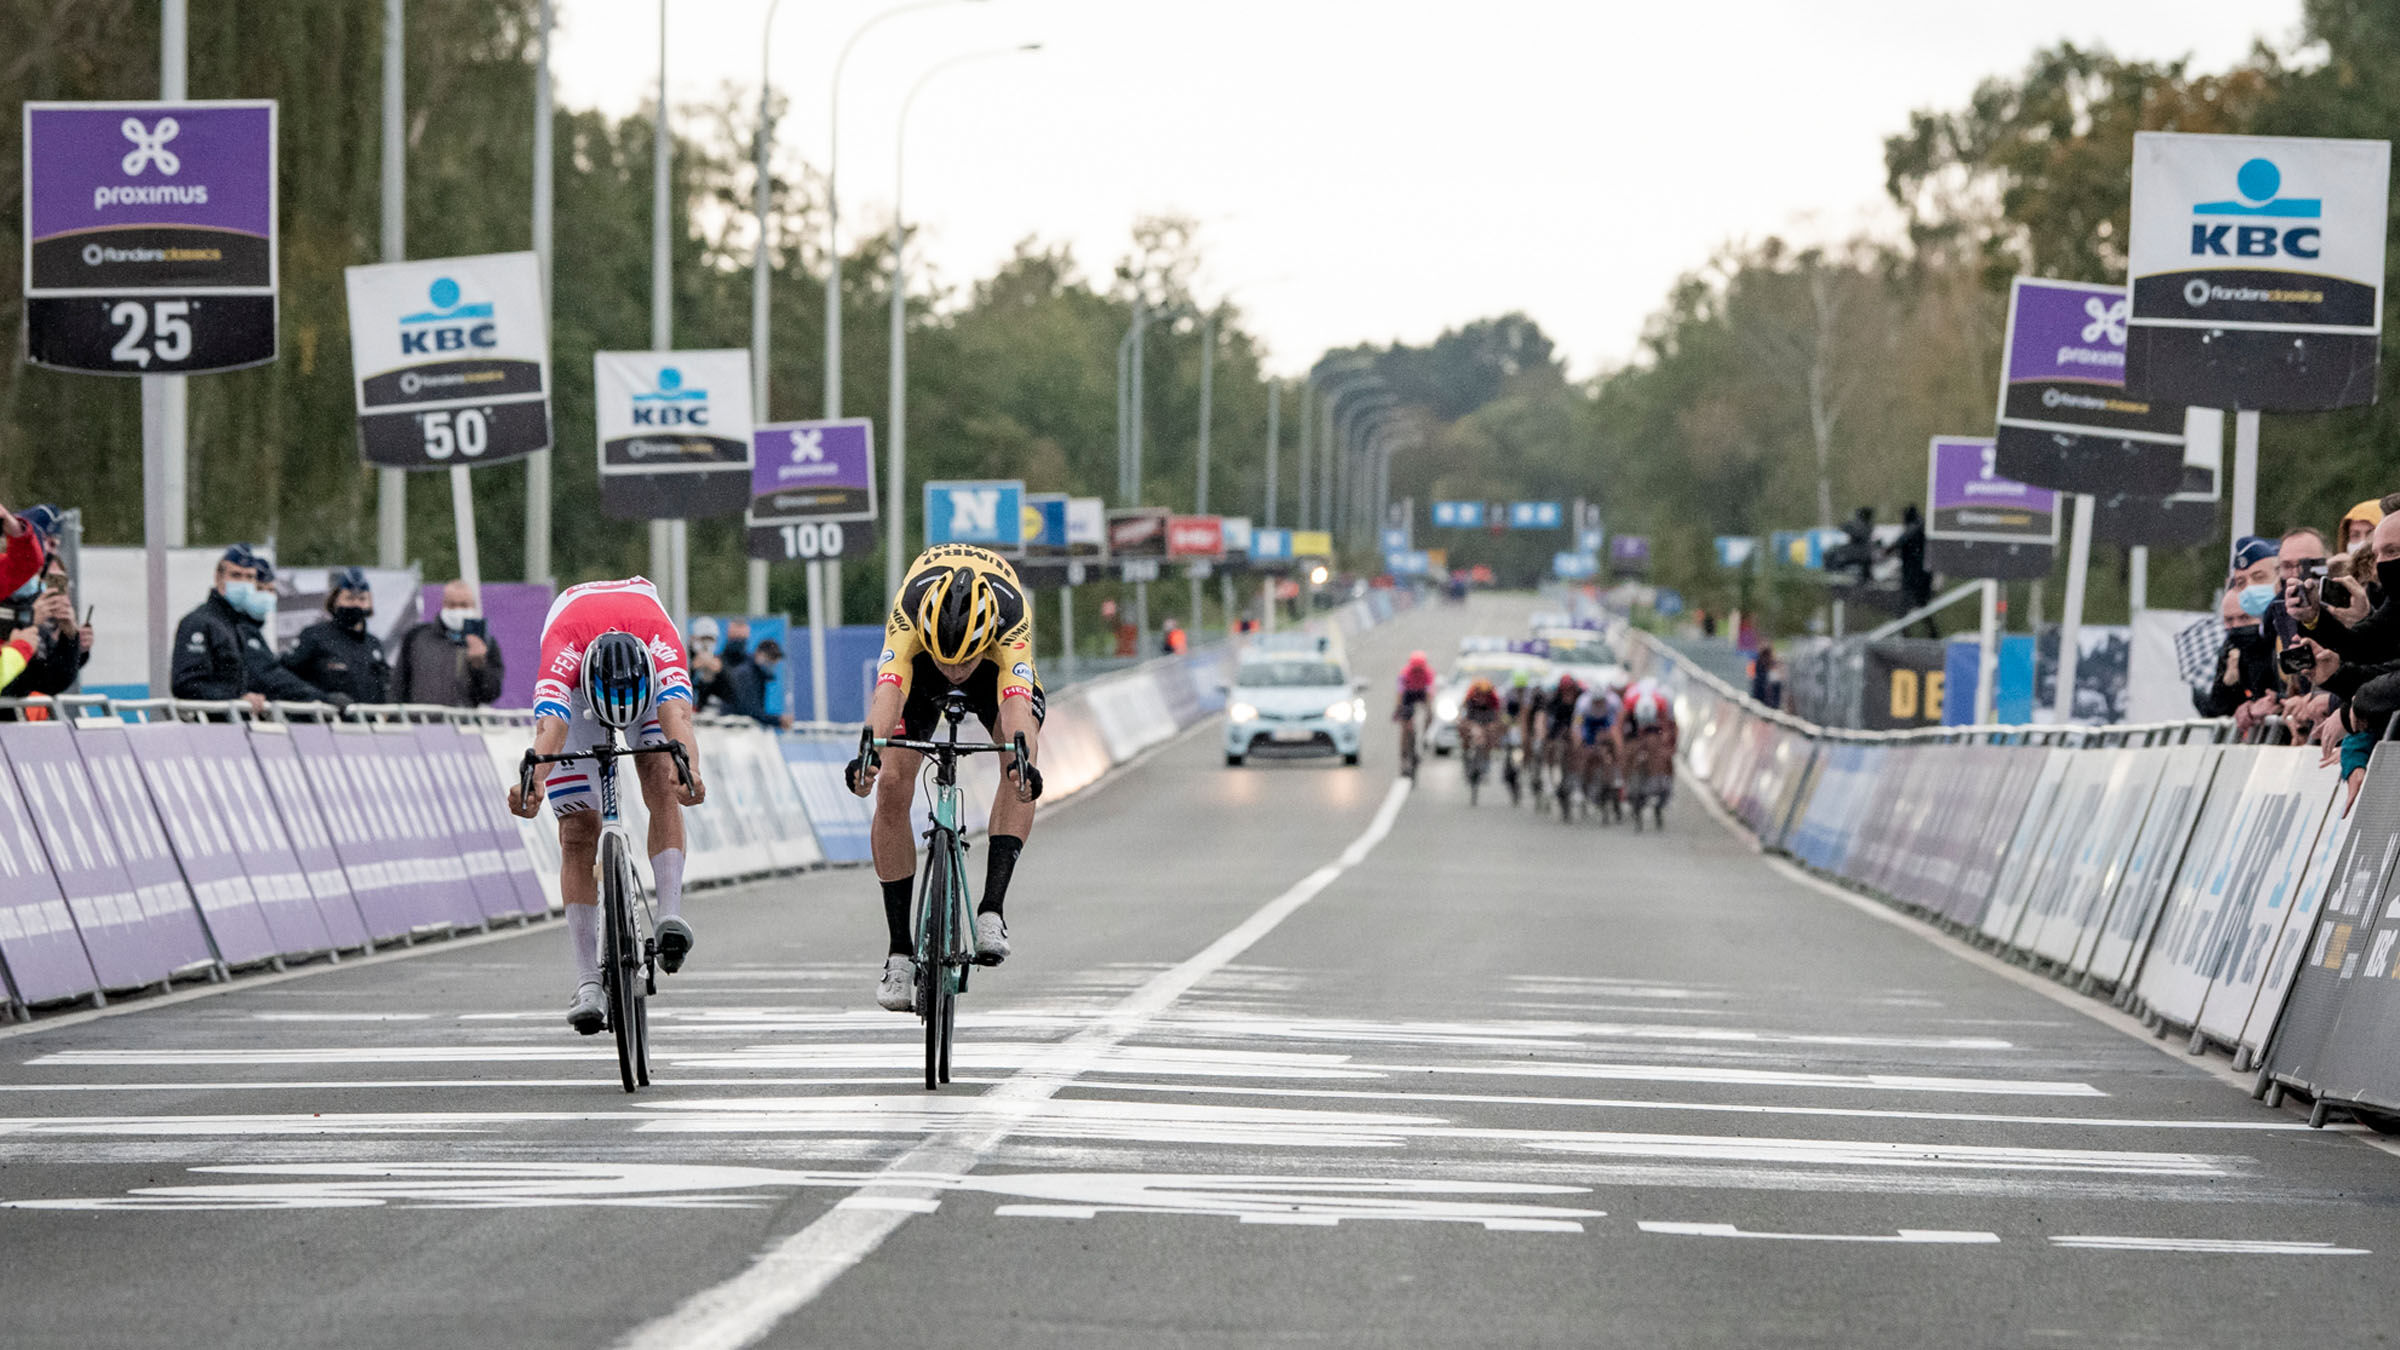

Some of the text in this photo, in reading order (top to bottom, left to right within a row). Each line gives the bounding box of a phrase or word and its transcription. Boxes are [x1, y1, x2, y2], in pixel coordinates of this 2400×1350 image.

[94, 185, 208, 210] proximus
[2191, 224, 2320, 259] KBC
[111, 302, 192, 367] 25
[401, 324, 497, 354] KBC
[2057, 346, 2126, 367] proxim
[423, 408, 488, 459] 50
[633, 406, 708, 426] KBC
[952, 491, 999, 530] N
[780, 523, 843, 559] 100
